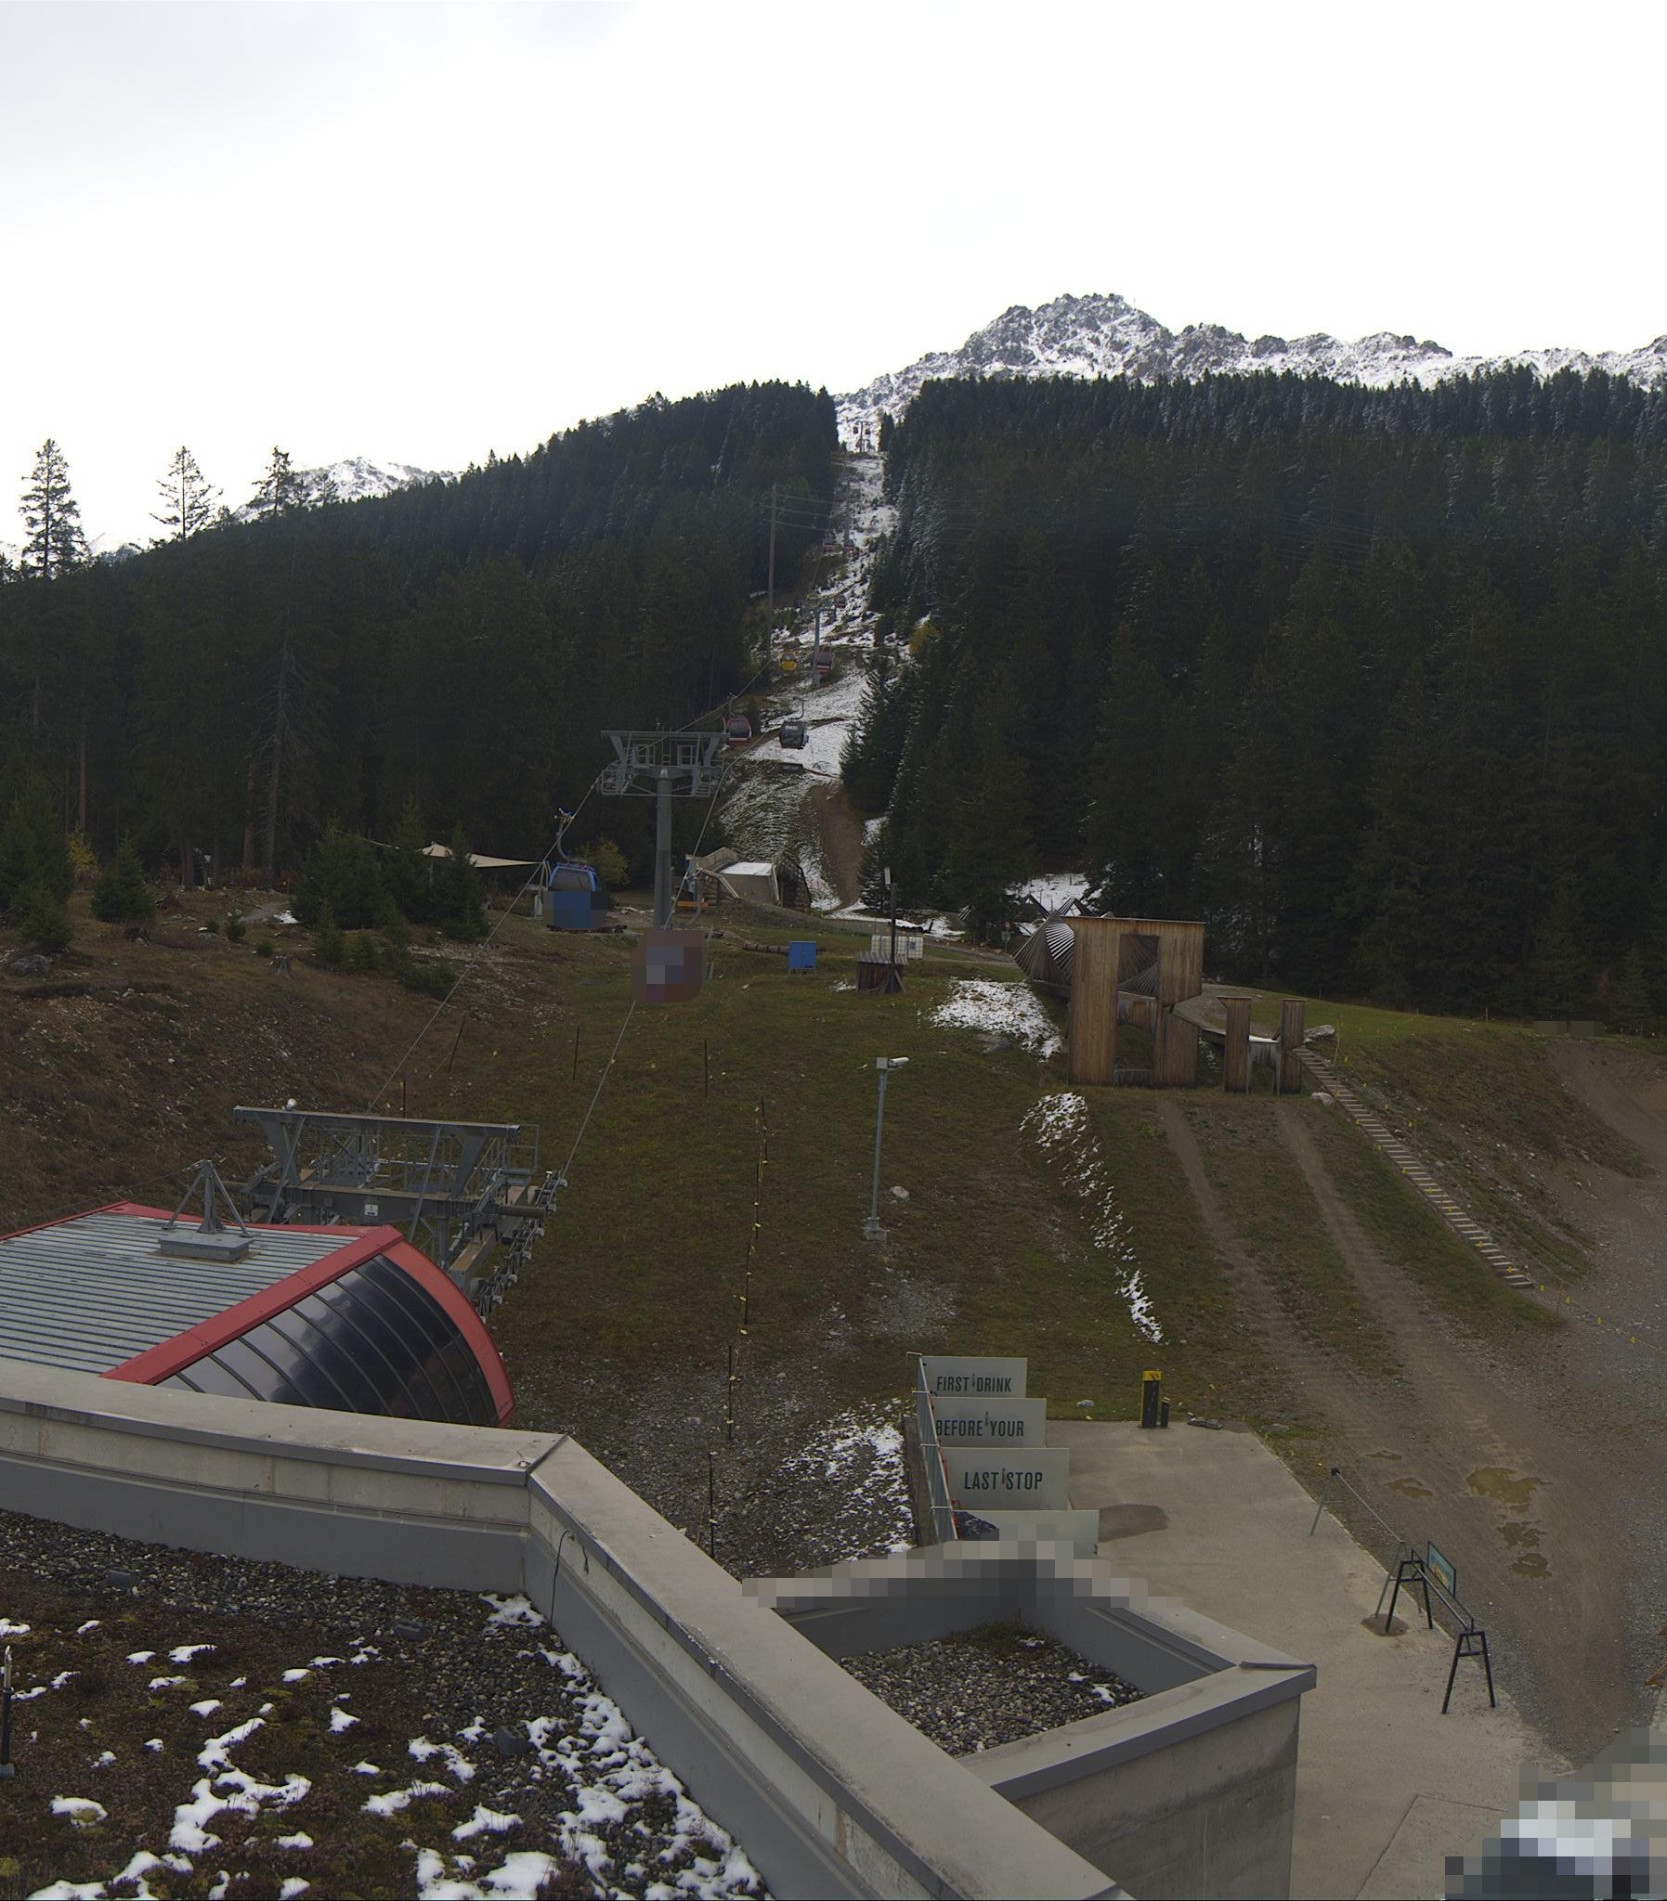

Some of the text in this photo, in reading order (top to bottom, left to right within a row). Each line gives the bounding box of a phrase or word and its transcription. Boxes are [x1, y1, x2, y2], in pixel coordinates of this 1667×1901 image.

[937, 1376, 1012, 1392] FIRST DRINK
[936, 1420, 1025, 1437] BEFORE YOUR
[964, 1472, 1043, 1490] LAST STOP
